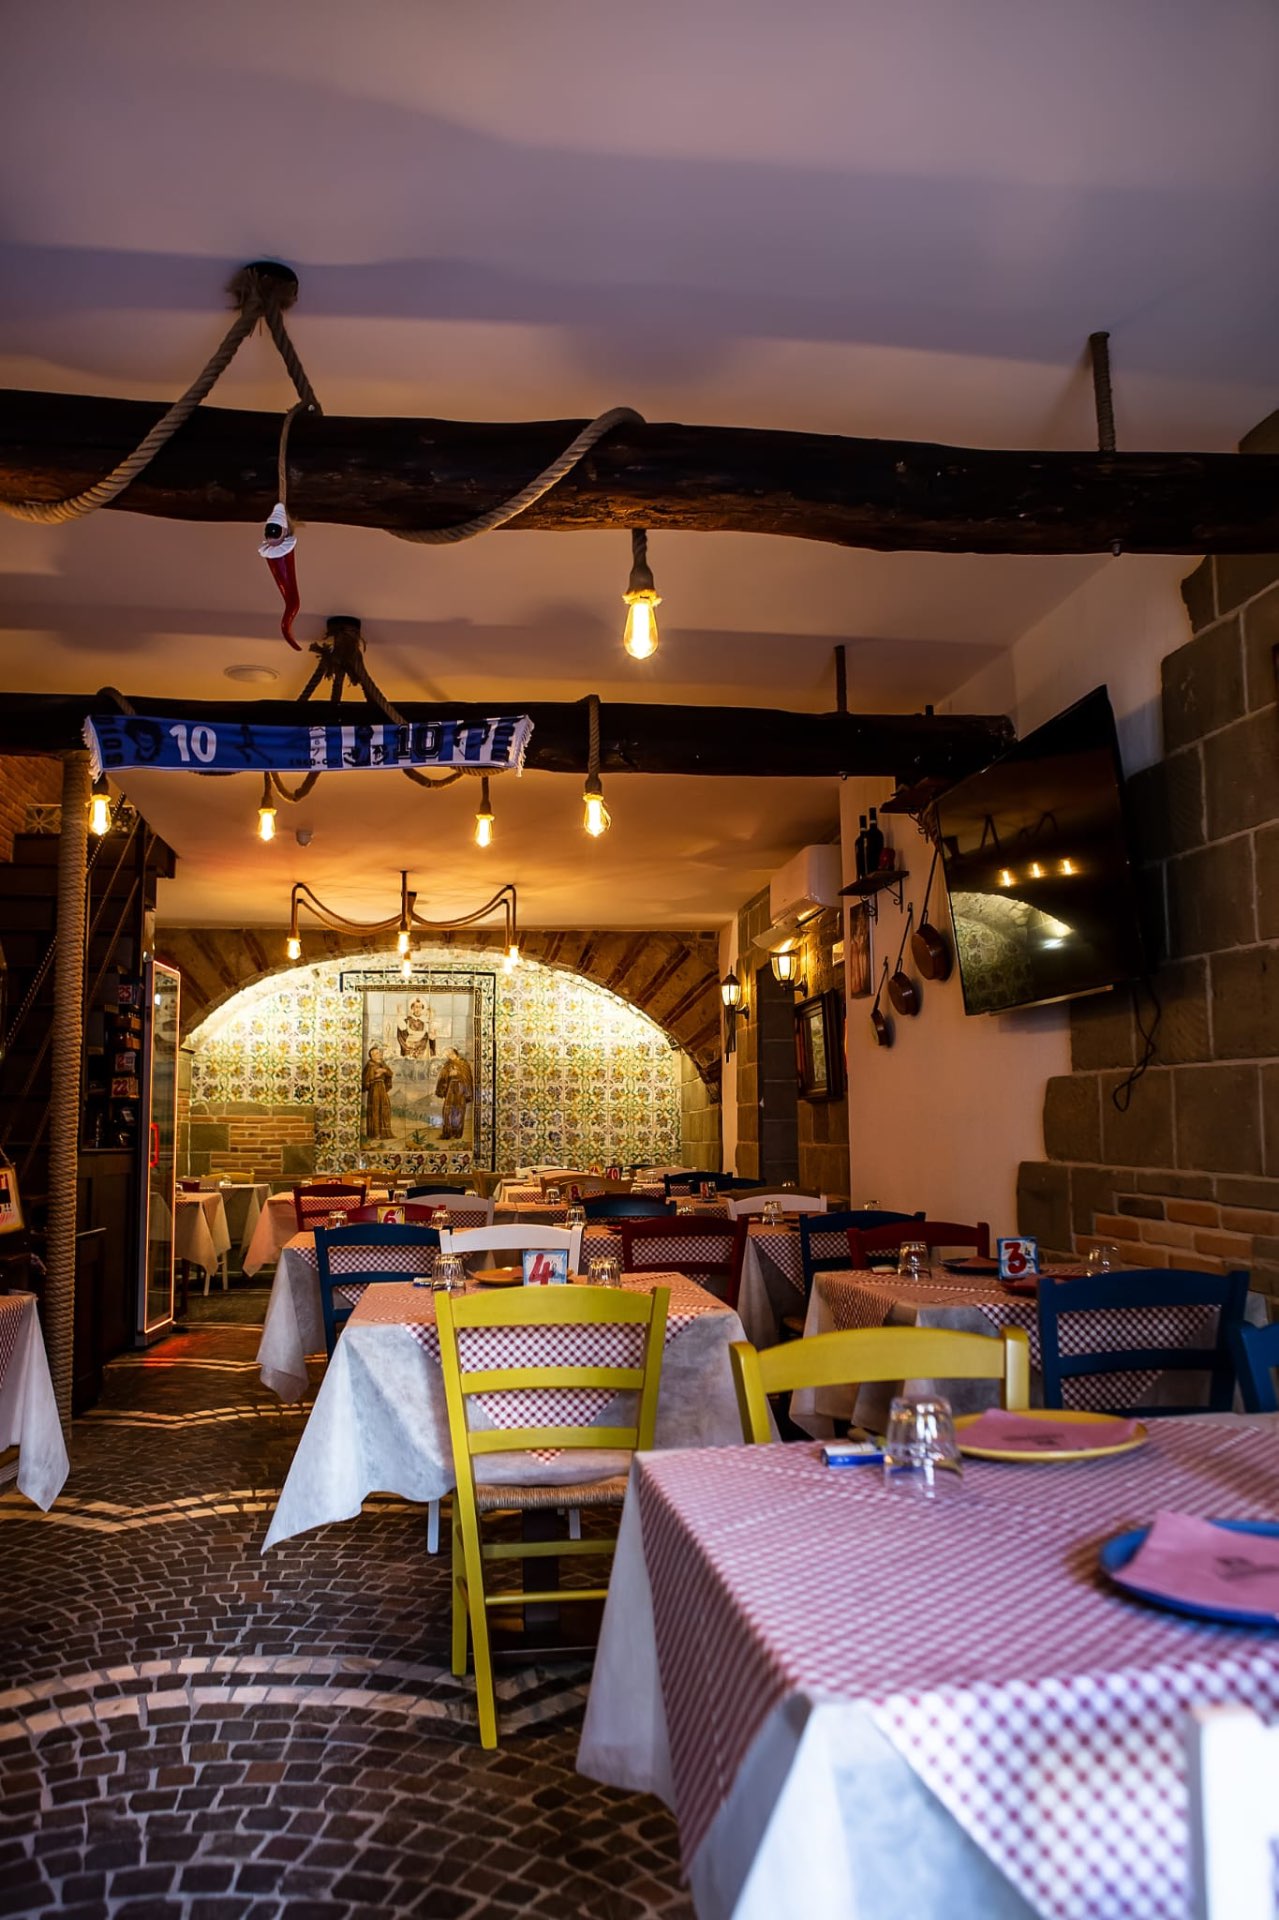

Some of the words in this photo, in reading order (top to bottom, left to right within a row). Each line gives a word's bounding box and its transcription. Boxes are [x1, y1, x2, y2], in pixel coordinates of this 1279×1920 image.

[169, 724, 217, 762] 10
[394, 722, 442, 759] 10
[529, 1252, 554, 1286] 4
[1004, 1242, 1027, 1274] 3
